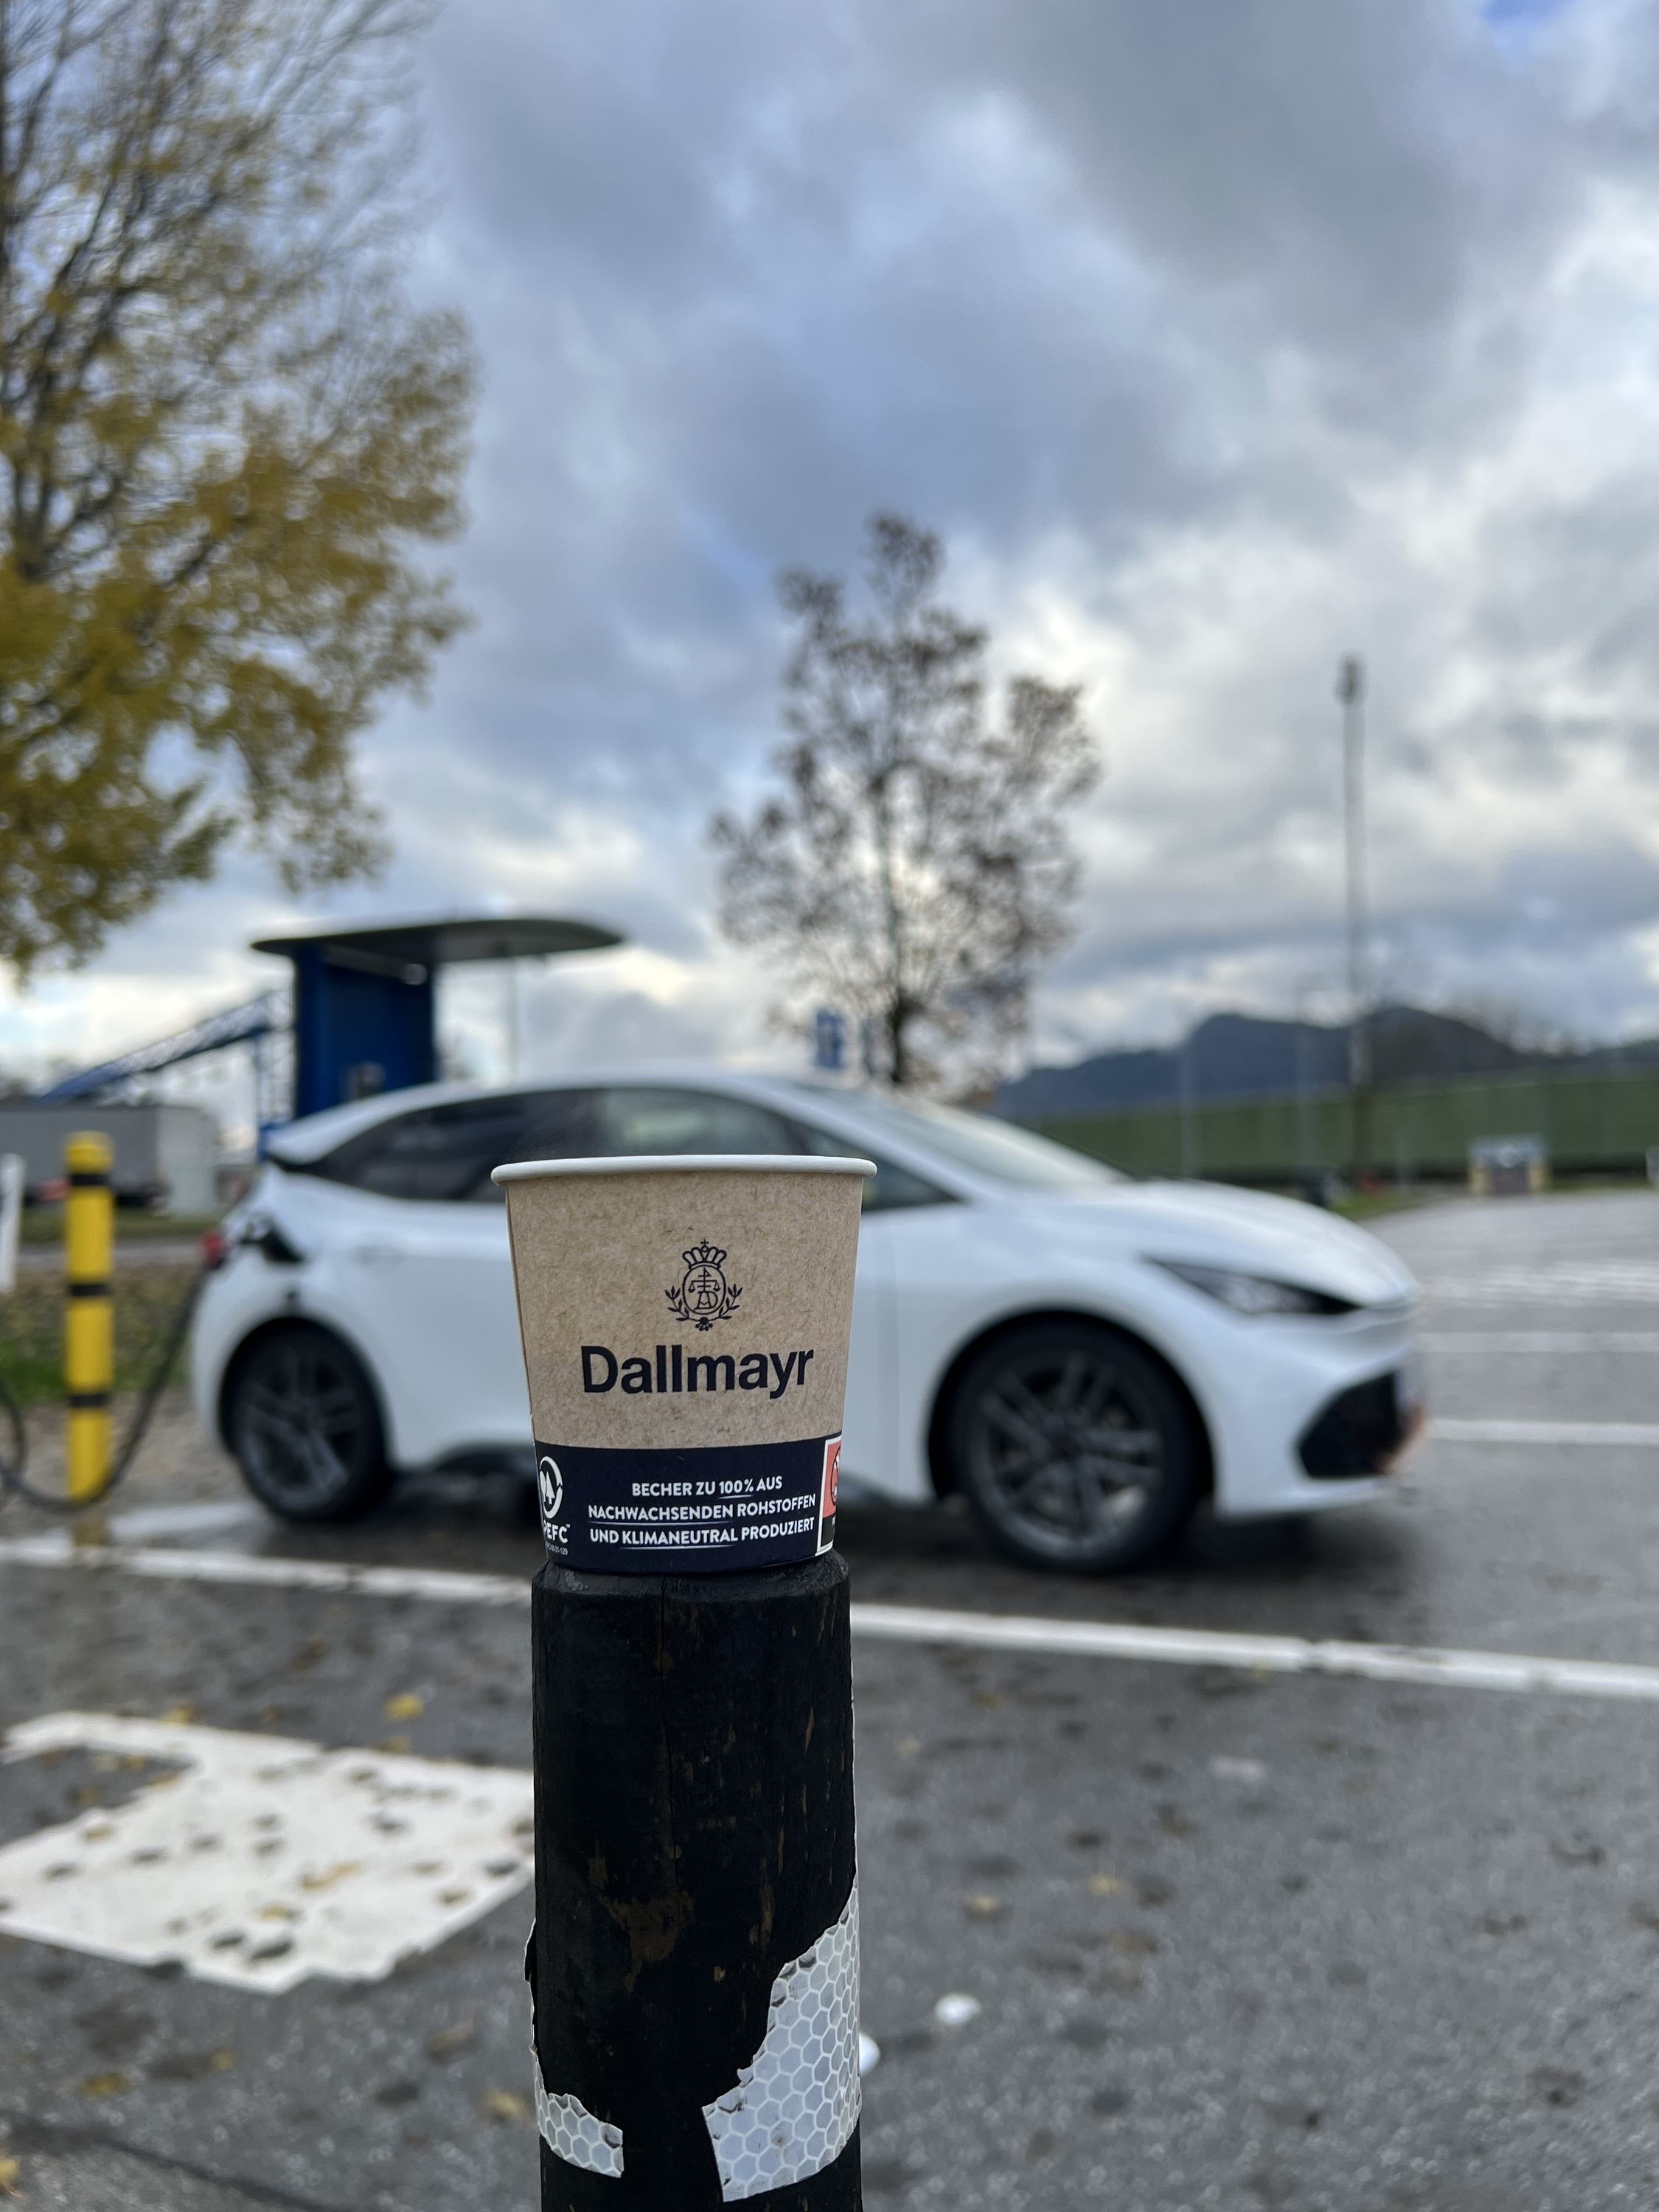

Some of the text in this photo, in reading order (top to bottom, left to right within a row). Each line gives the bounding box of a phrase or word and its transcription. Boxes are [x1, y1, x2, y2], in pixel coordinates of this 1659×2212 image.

[581, 1344, 814, 1399] Dallmayr
[632, 1476, 782, 1497] BECHER ZU 100% AUS
[588, 1494, 816, 1521] NACHWACHSENDEN ROHSTOFFEN
[590, 1528, 619, 1543] UND
[622, 1528, 739, 1545] KLIMANEUTRAL
[741, 1517, 815, 1541] PRODUZIERT
